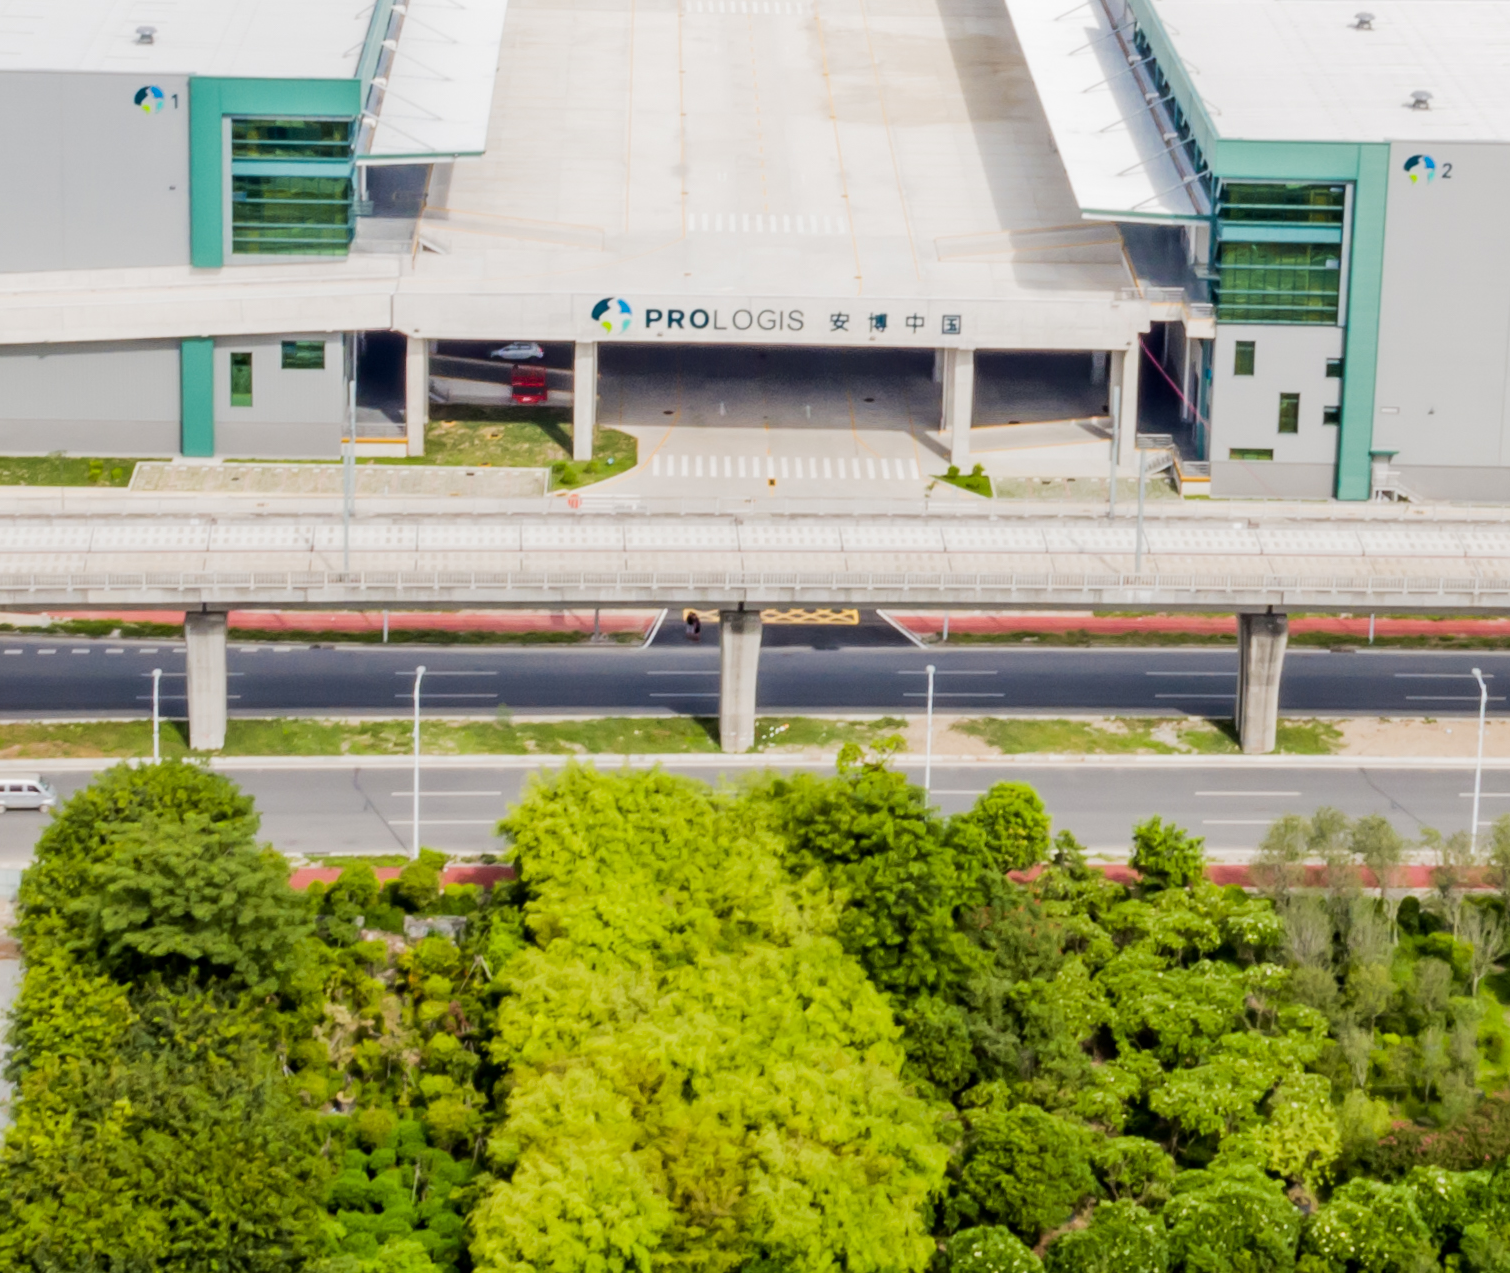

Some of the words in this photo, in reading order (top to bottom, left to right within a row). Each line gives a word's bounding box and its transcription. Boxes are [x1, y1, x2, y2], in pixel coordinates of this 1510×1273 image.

[170, 93, 179, 109] 1
[1441, 162, 1453, 179] 2
[645, 308, 805, 331] PROLOGIS
[829, 311, 962, 335] 安博中国
